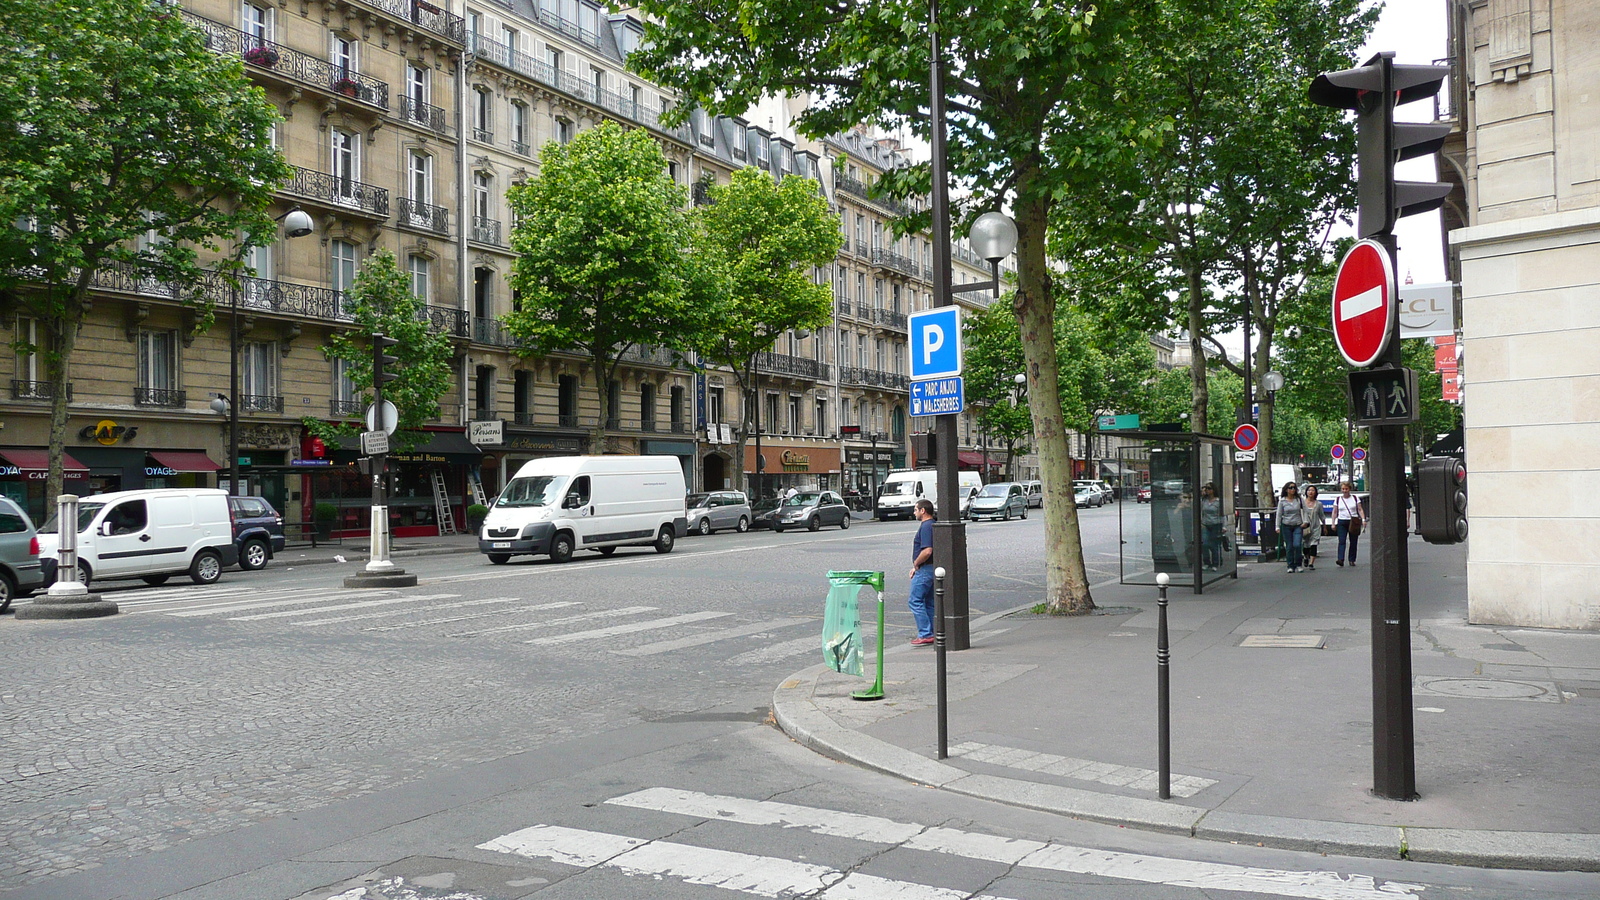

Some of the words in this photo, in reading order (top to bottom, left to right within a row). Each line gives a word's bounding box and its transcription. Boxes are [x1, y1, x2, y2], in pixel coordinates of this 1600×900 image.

[923, 324, 944, 365] P
[924, 382, 938, 397] PARC
[939, 380, 957, 395] ANJOU
[923, 397, 960, 413] MALESHERBES
[472, 424, 501, 436] Persans
[145, 467, 178, 476] OYAGES
